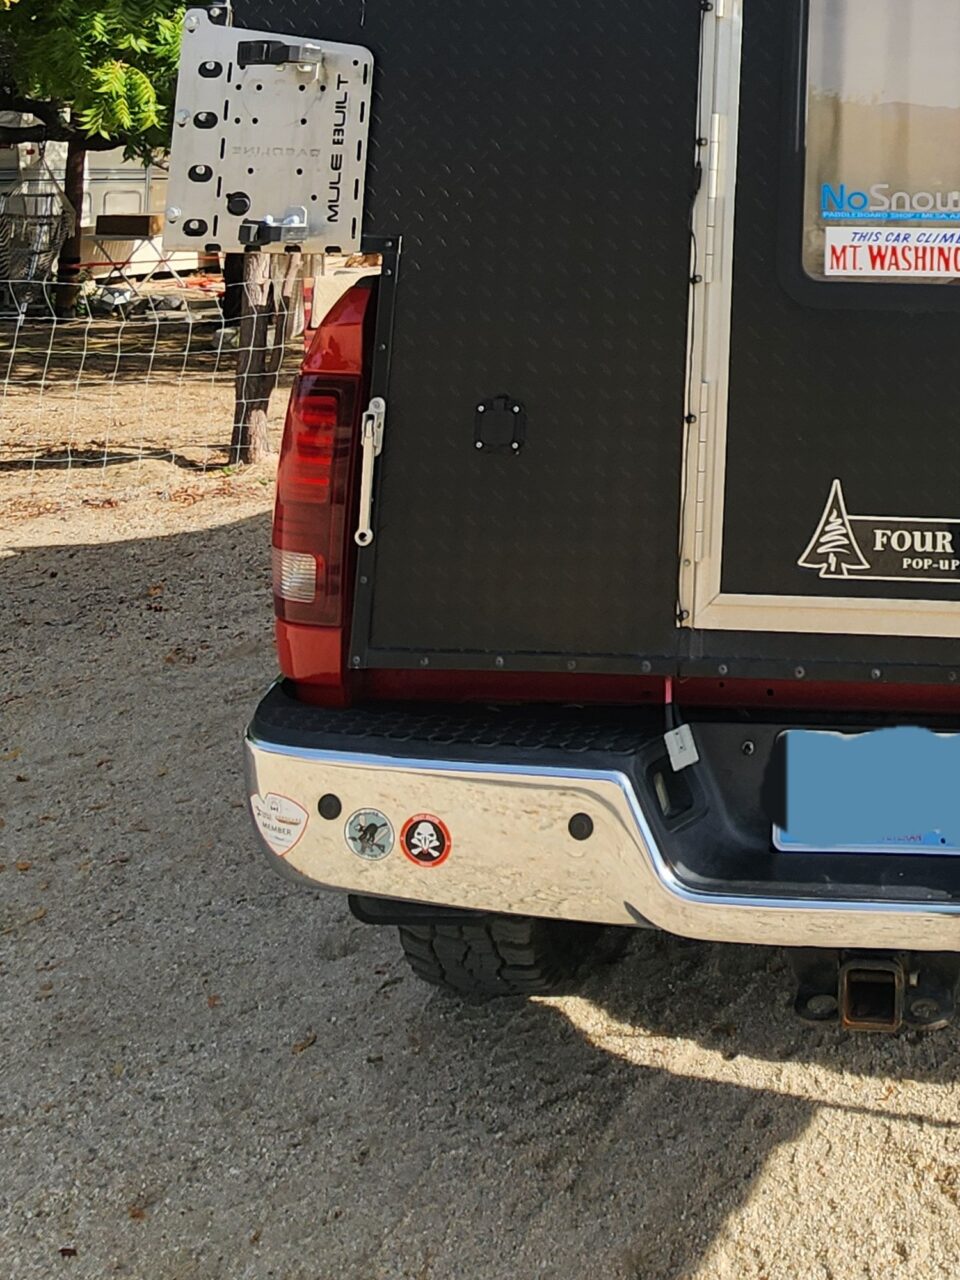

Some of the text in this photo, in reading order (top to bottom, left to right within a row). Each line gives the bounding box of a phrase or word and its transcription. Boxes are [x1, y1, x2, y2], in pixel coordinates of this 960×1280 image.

[327, 74, 349, 222] MULE BUILT
[822, 210, 888, 219] PADDLEBOARD
[850, 231, 880, 243] THIS
[885, 232, 911, 244] CAR
[829, 245, 863, 271] MT.
[873, 529, 954, 553] FOUR
[902, 557, 960, 571] POP-UP
[262, 821, 292, 835] MEMBER
